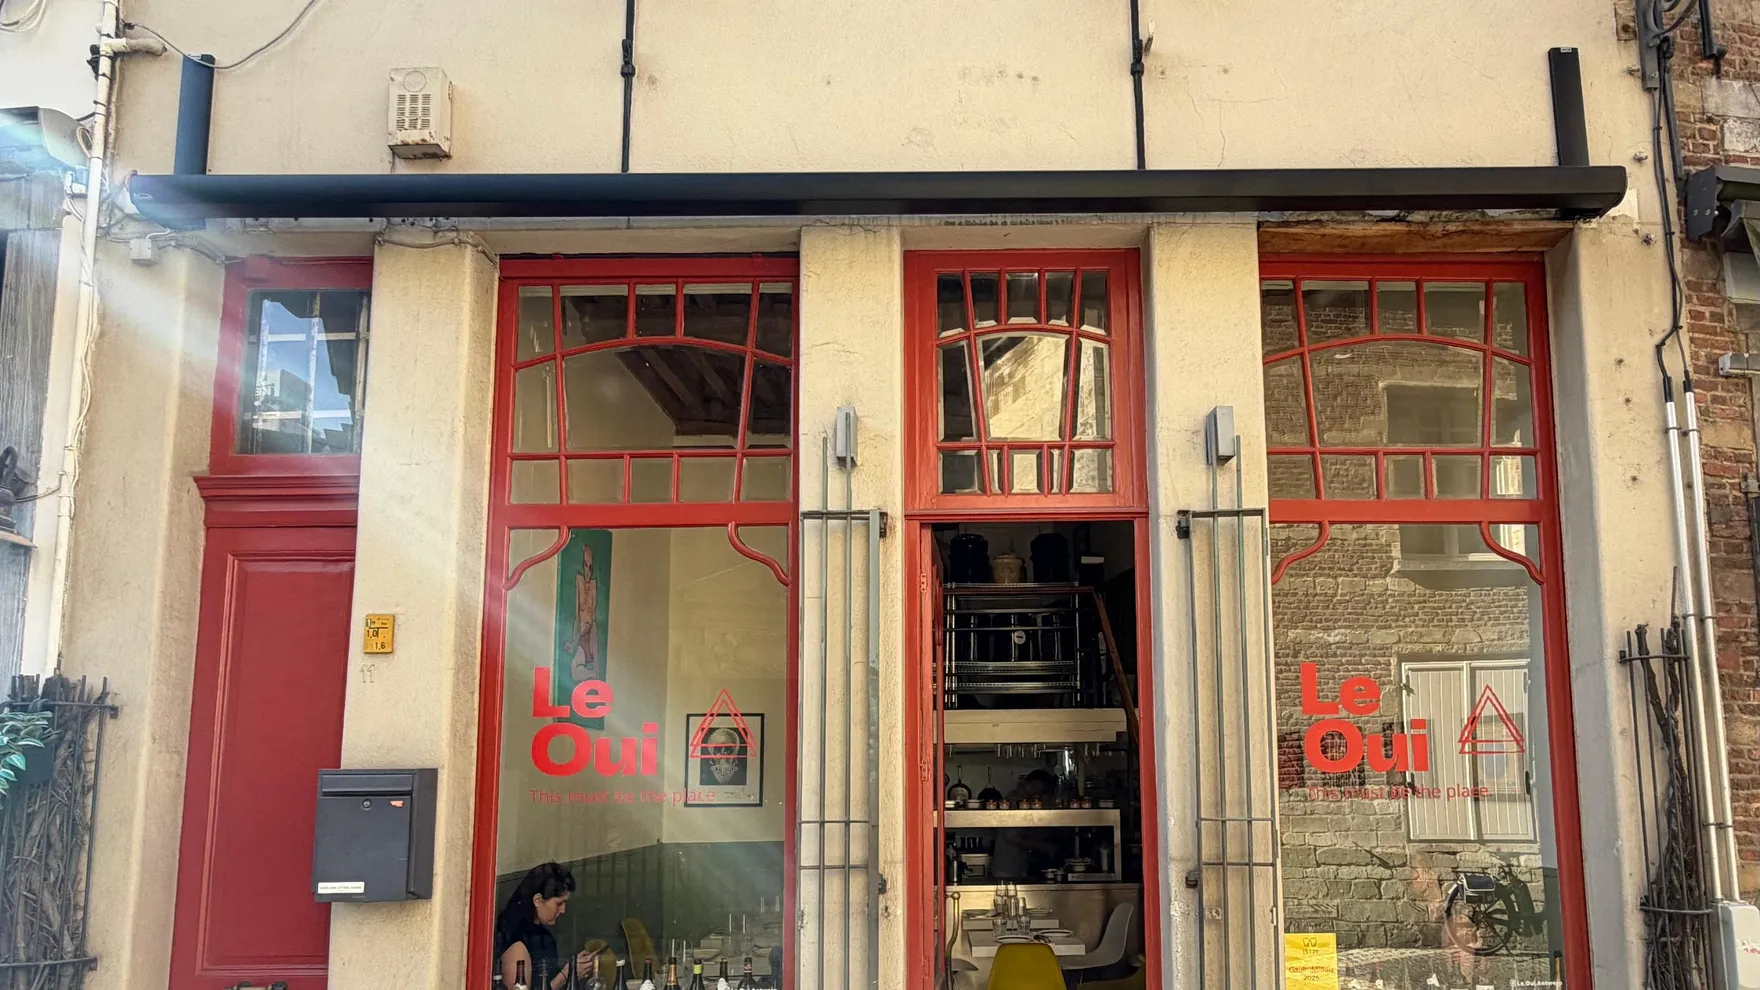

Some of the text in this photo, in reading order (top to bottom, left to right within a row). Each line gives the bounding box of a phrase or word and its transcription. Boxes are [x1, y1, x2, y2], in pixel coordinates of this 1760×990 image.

[375, 641, 386, 650] 1,6
[532, 666, 613, 718] Le
[1301, 662, 1381, 715] Le
[531, 722, 658, 777] Oui
[1304, 719, 1429, 773] Oui
[530, 789, 562, 804] This
[568, 789, 609, 803] must
[614, 788, 635, 804] be
[641, 788, 666, 803] the
[672, 788, 715, 807] place
[1308, 784, 1488, 802] This must be the place
